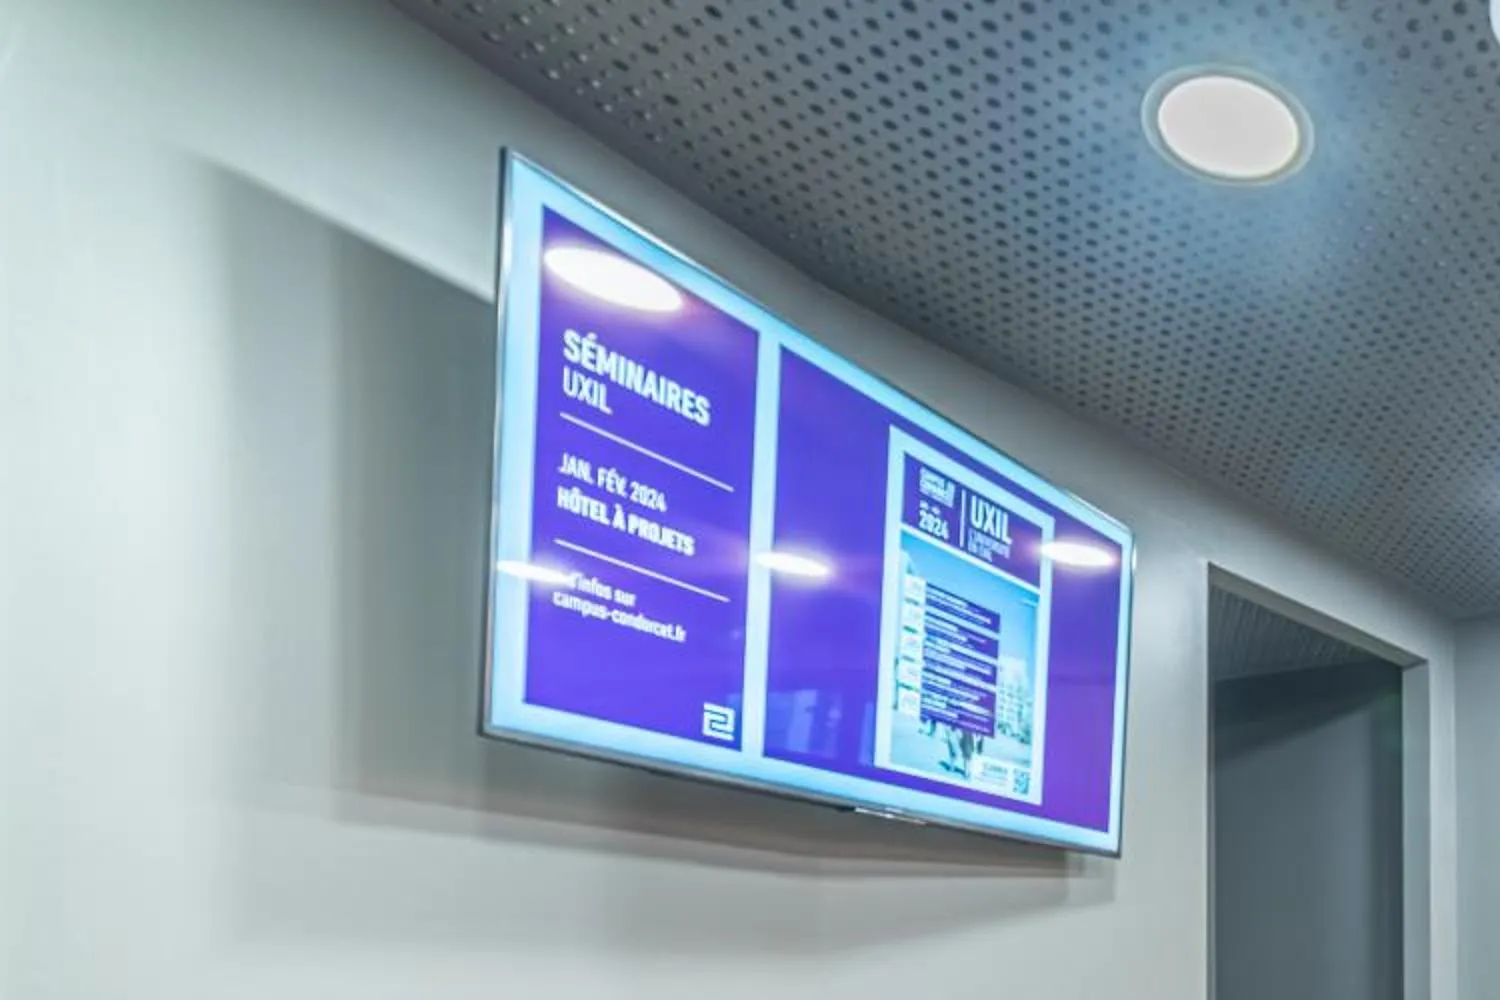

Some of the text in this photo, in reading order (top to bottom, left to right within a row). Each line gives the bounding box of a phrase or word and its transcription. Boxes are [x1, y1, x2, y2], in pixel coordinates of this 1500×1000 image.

[563, 329, 711, 426] SÉMINAIRES
[563, 365, 613, 415] UXIL
[558, 452, 594, 485] JAN.
[630, 481, 667, 512] 2024
[557, 485, 696, 556] HÔTEL À PROJETS
[919, 510, 949, 540] 2024
[970, 494, 1012, 545] UXIL
[552, 591, 686, 643] campus-condorcet.fr
